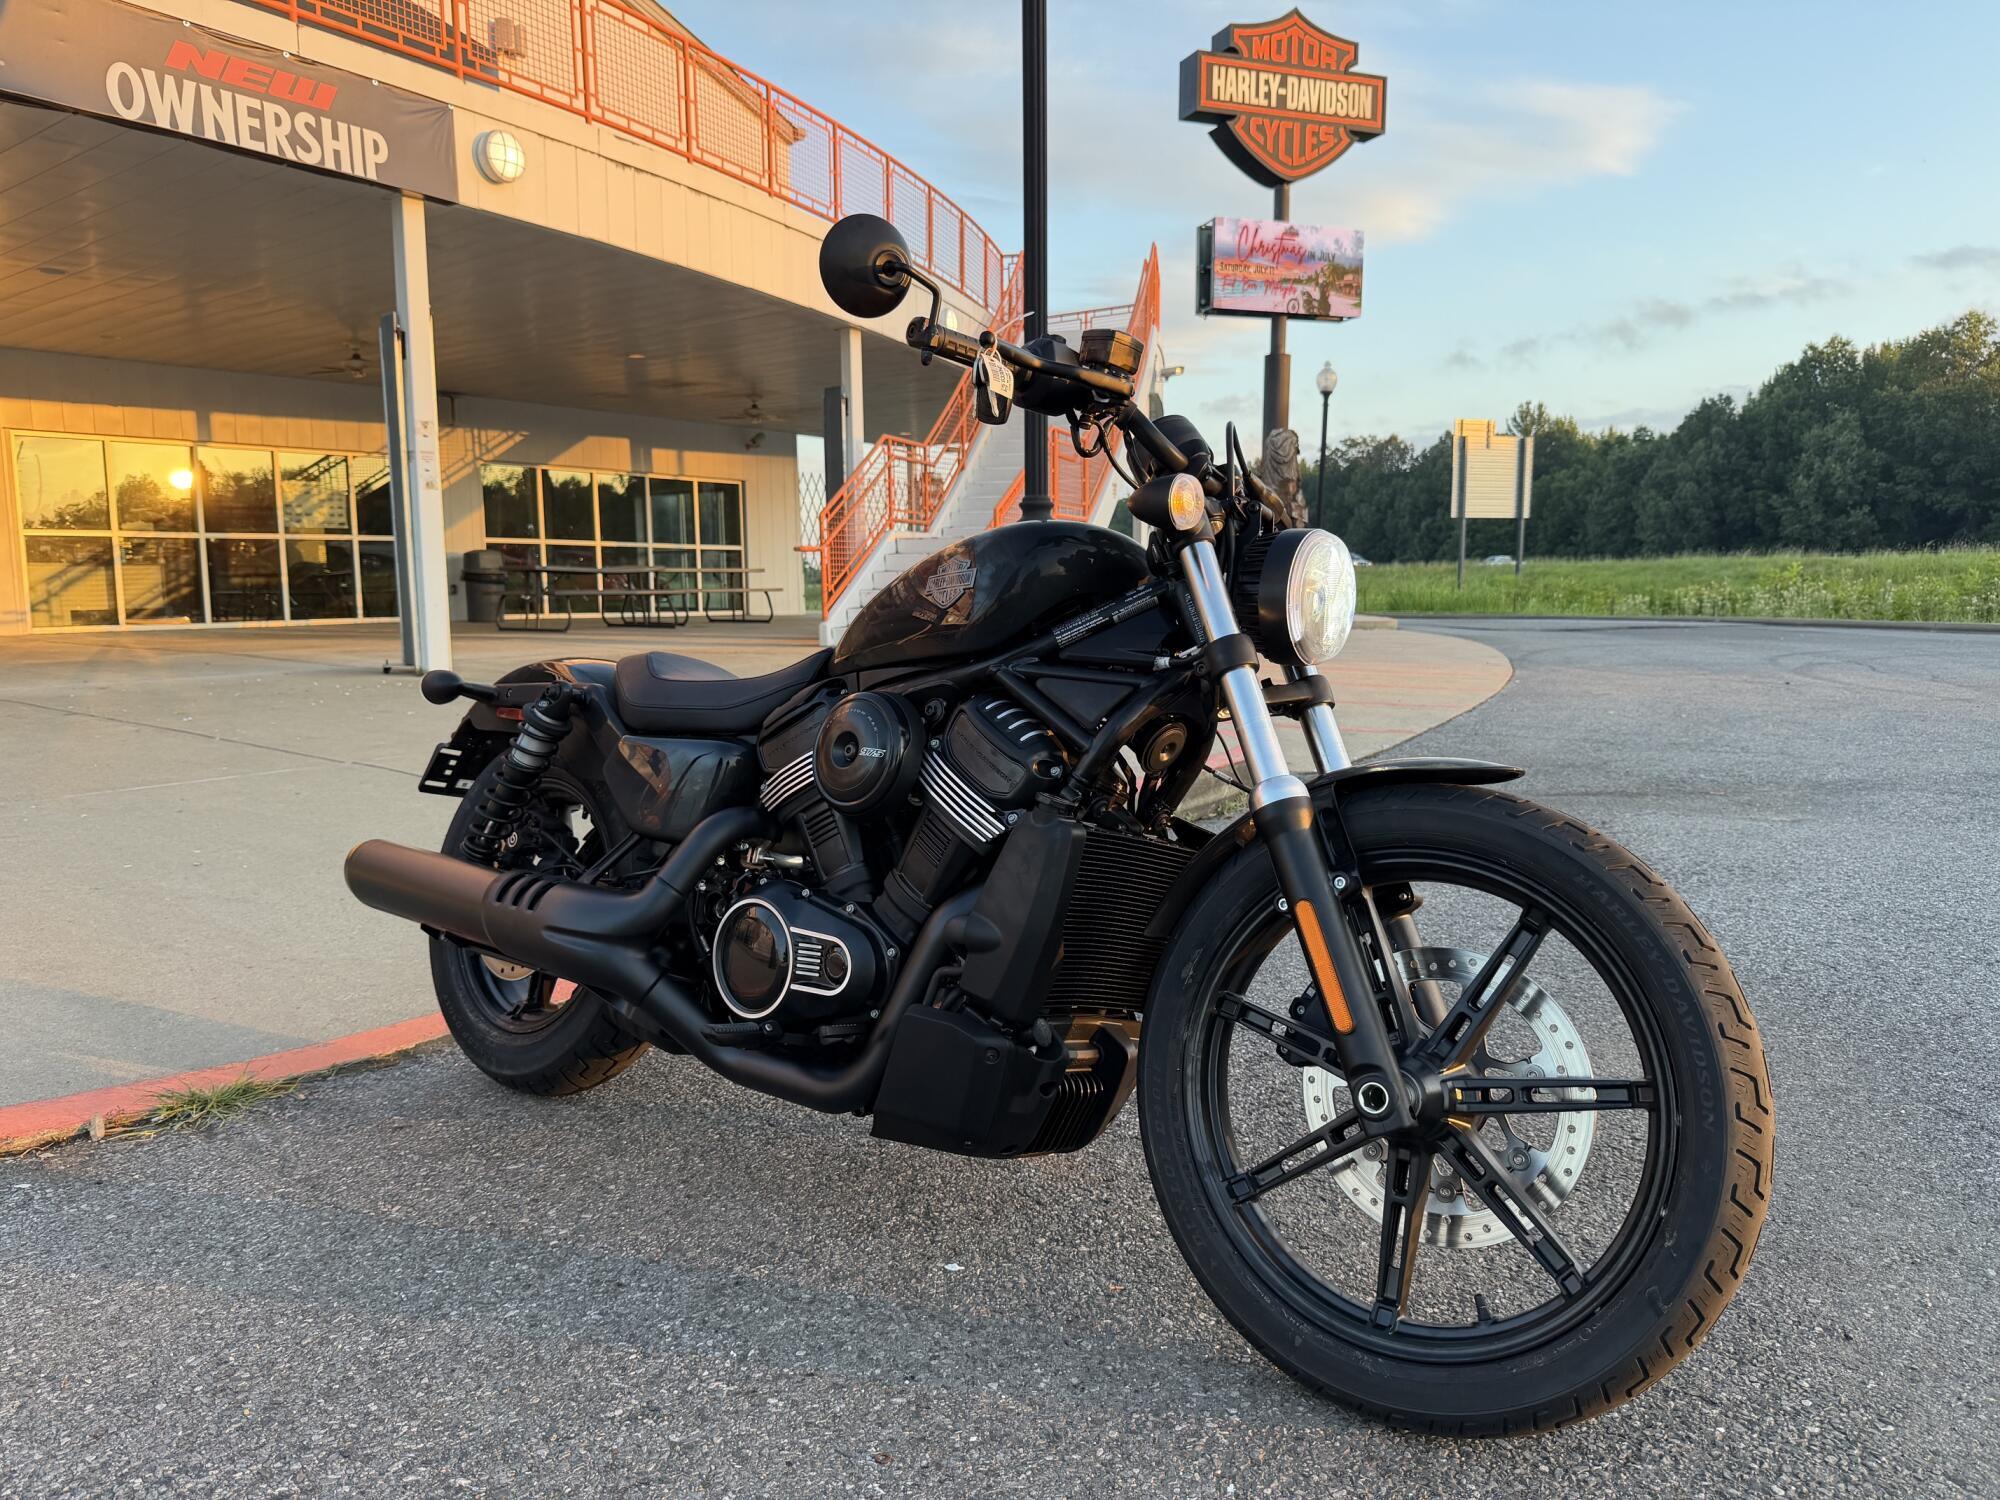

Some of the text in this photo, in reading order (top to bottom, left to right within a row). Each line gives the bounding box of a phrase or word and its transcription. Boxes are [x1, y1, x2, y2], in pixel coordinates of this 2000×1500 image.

[164, 39, 338, 111] NEW
[1252, 26, 1337, 71] MOTOR
[1212, 65, 1373, 120] HARLEY-DAVIDSON
[105, 61, 389, 180] OWNERSHIP
[1250, 117, 1335, 166] CYCLES
[1237, 226, 1307, 264] Christmas
[1317, 251, 1336, 262] JULY
[1575, 873, 1716, 1135] HARLEY-DAVIDSON
